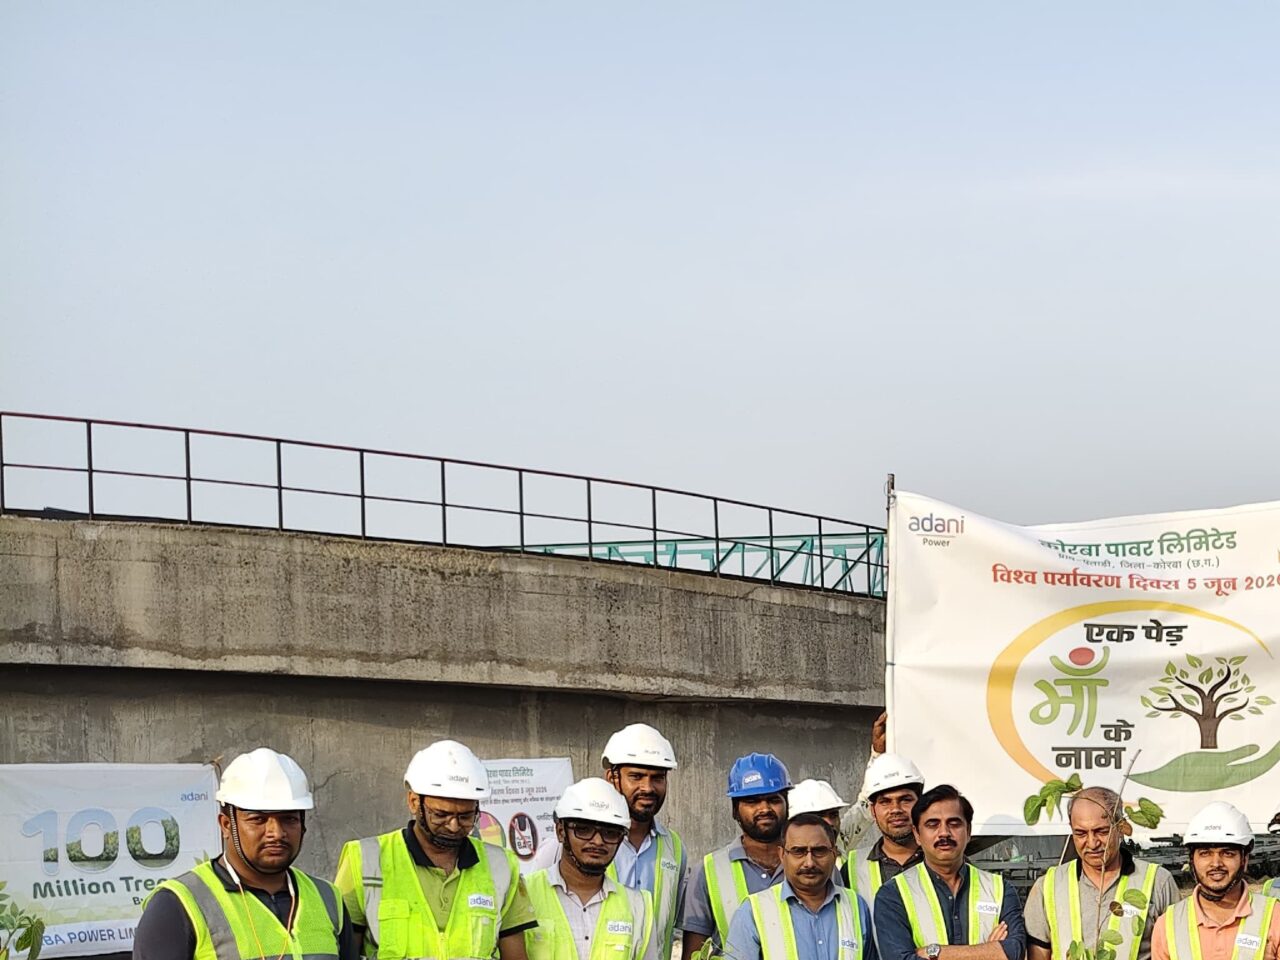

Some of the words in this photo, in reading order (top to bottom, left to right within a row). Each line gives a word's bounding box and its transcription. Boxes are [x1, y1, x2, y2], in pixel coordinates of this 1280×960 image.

[908, 513, 965, 534] adani
[922, 537, 950, 547] Power
[1105, 540, 1154, 557] पावर
[1158, 527, 1237, 556] लिमिटेड
[992, 563, 1037, 585] विश्व
[1043, 567, 1122, 589] पर्यावरण
[1128, 573, 1180, 591] दिवस
[1187, 578, 1197, 590] 5
[1203, 577, 1238, 596] जून
[1084, 623, 1138, 643] एक
[1141, 619, 1188, 646] पेड़
[1100, 719, 1135, 742] के
[1051, 747, 1127, 769] नाम
[180, 792, 208, 802] adani
[20, 807, 182, 876] 100
[33, 878, 116, 899] Million
[470, 897, 493, 907] adani
[67, 929, 115, 944] POWER
[608, 923, 632, 933] adani
